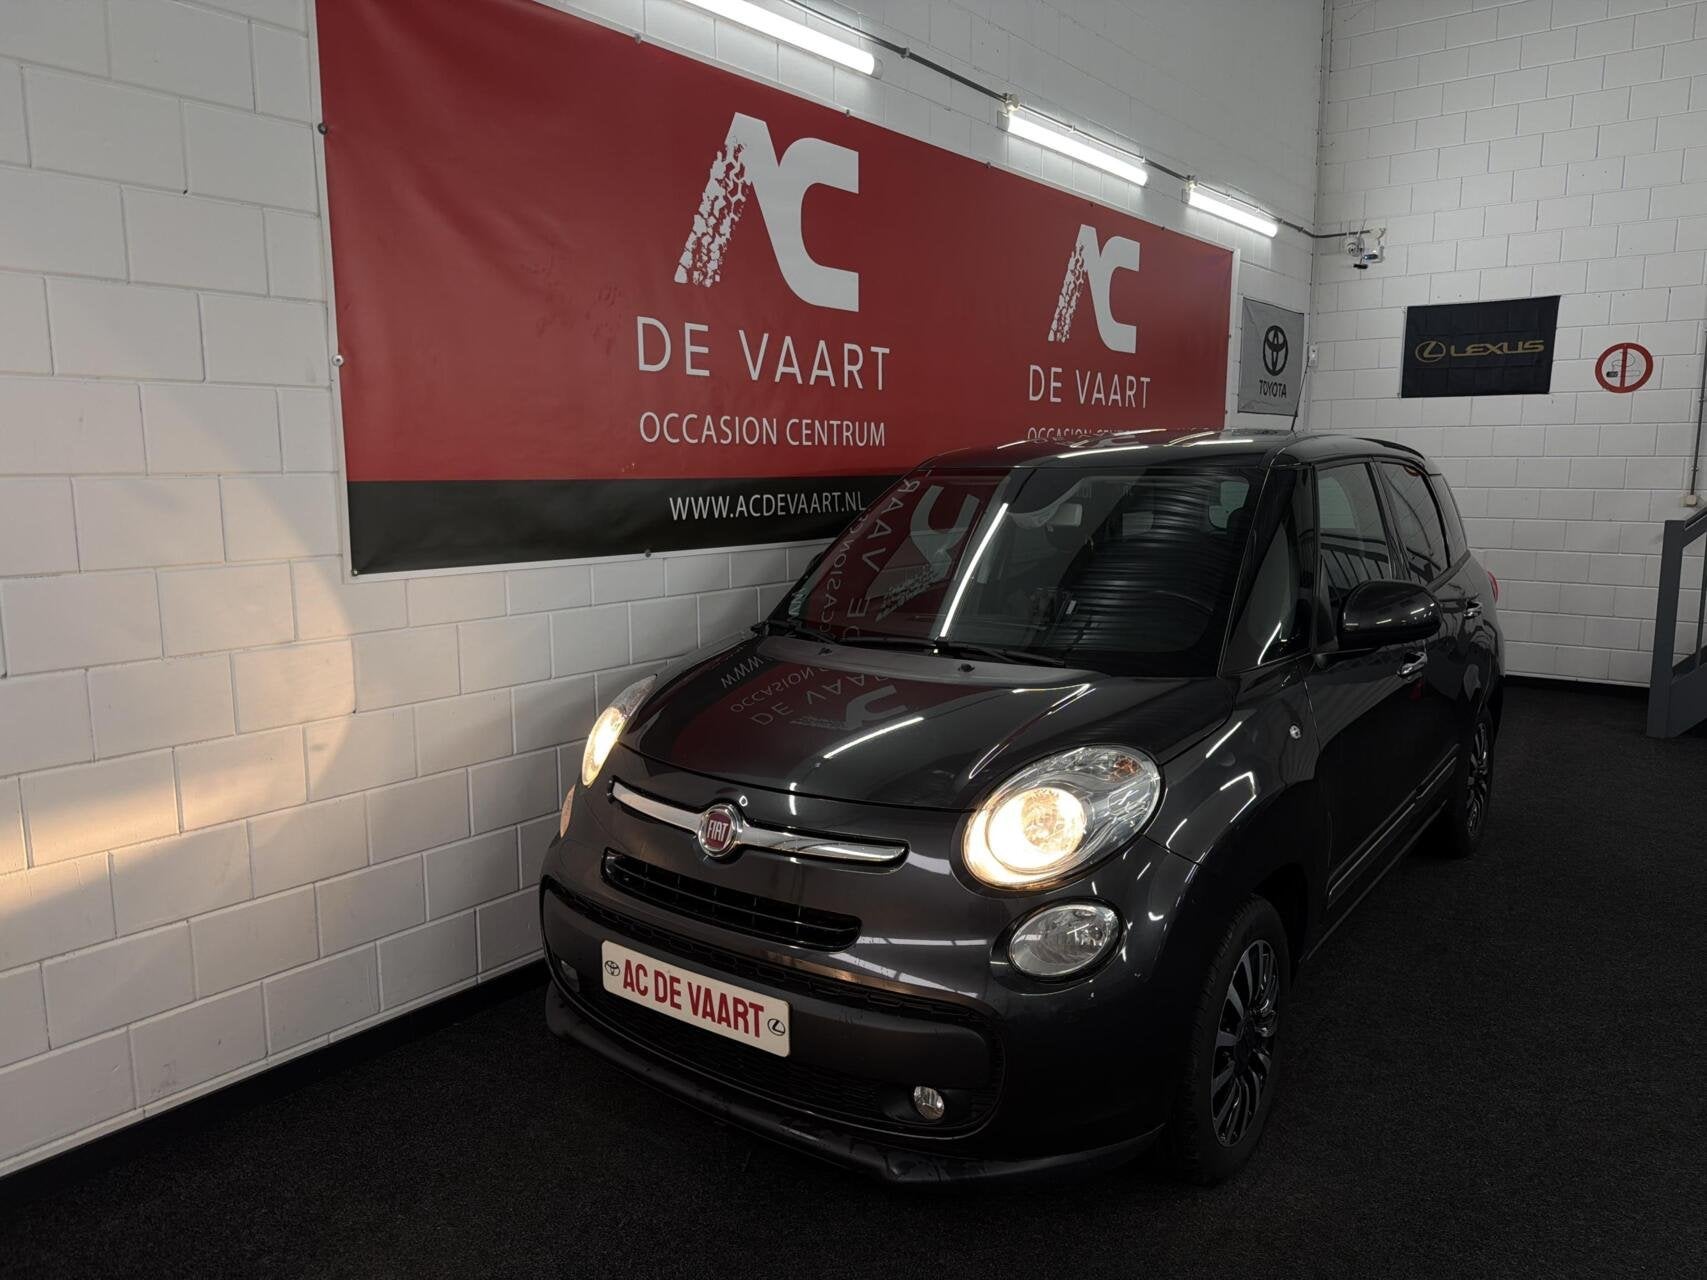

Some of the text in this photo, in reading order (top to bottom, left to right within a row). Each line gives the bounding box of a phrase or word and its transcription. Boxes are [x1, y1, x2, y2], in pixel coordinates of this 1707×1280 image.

[674, 112, 859, 312] AC
[1048, 224, 1140, 354] AC
[637, 316, 890, 390] DE VAART
[1451, 340, 1545, 358] LEXUS
[1029, 364, 1151, 409] DE VAART
[1259, 379, 1287, 398] TOYOTA
[640, 411, 886, 447] OCCASION CENTRUM
[669, 491, 867, 521] WWW.ACDEVAART.NL
[707, 820, 729, 842] FIAT
[623, 959, 765, 1038] AC DE VAART
